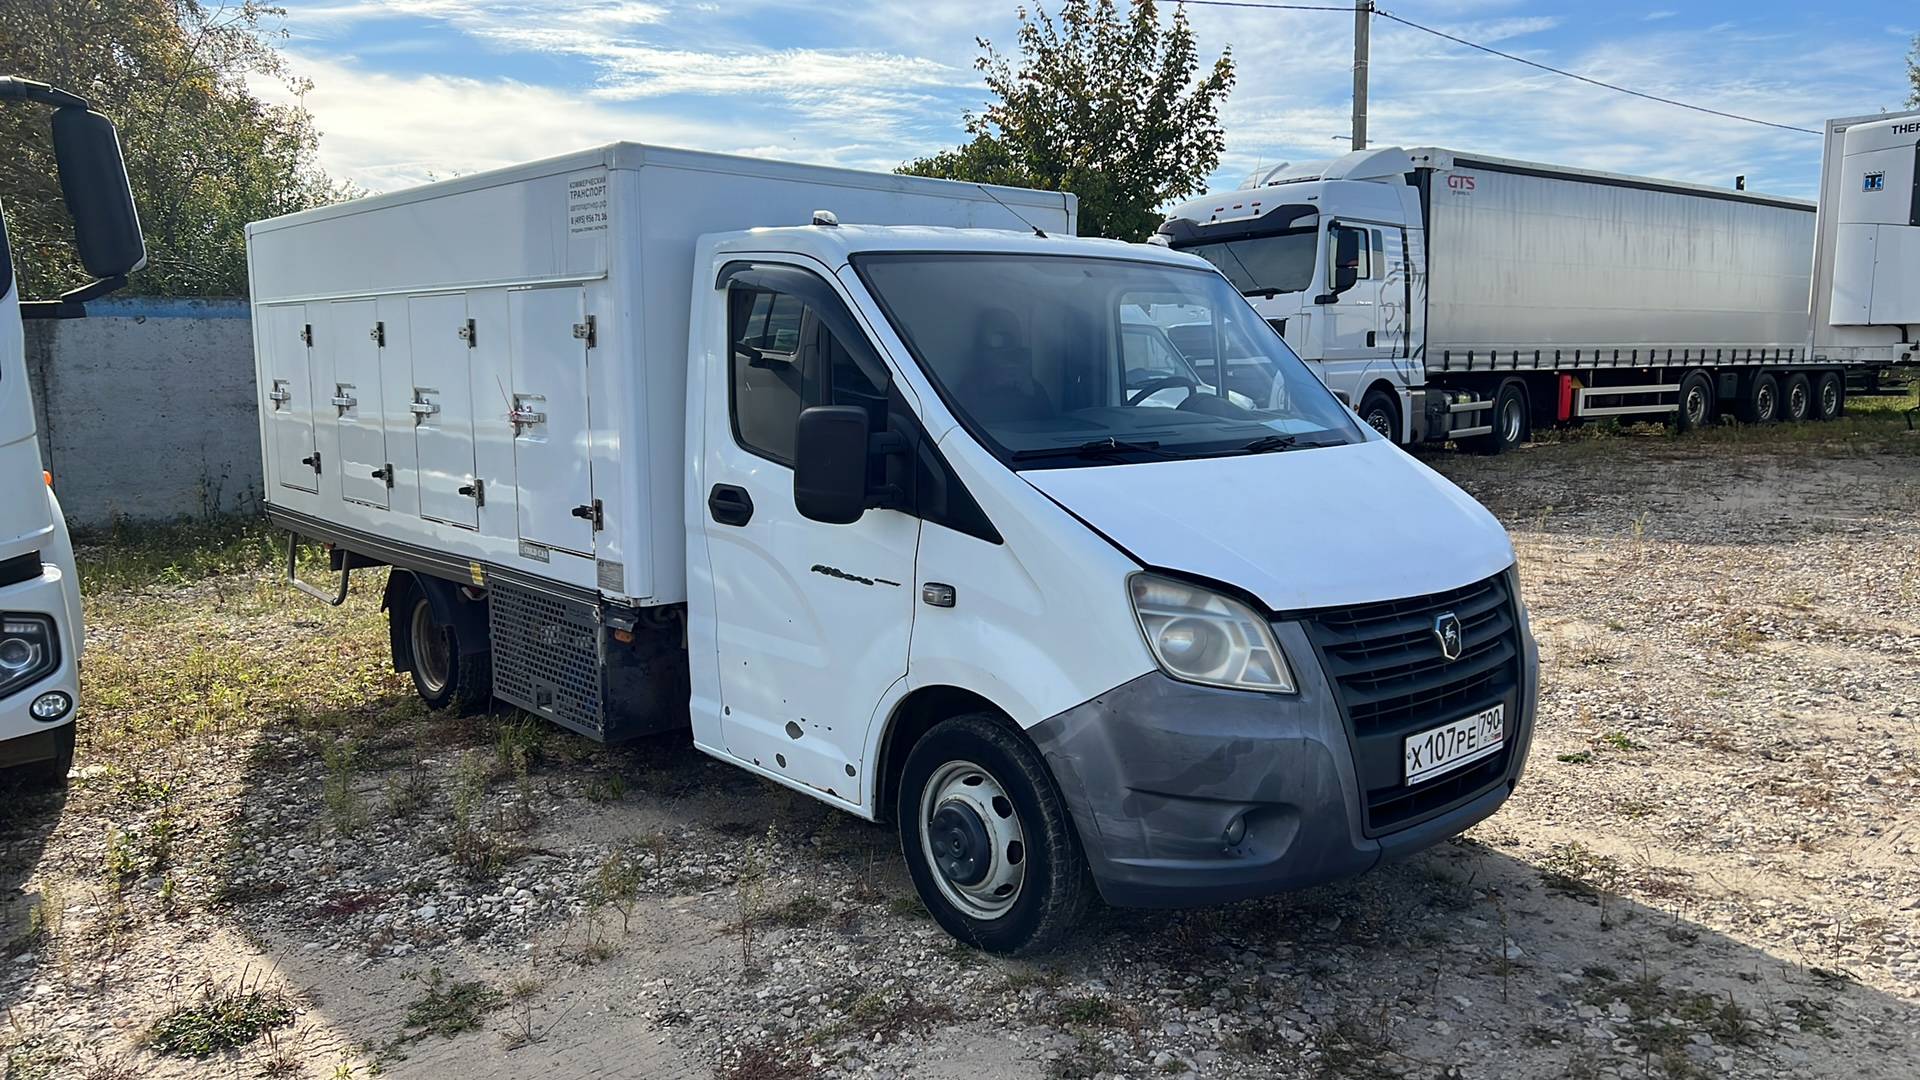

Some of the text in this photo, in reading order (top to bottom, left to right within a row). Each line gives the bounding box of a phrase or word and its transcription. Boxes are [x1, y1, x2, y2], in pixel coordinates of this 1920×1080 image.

[1448, 175, 1475, 190] GTS
[570, 185, 606, 200] ТРАНСПОРТ
[1411, 726, 1476, 771] Х107РЕ
[1480, 709, 1500, 736] 790
